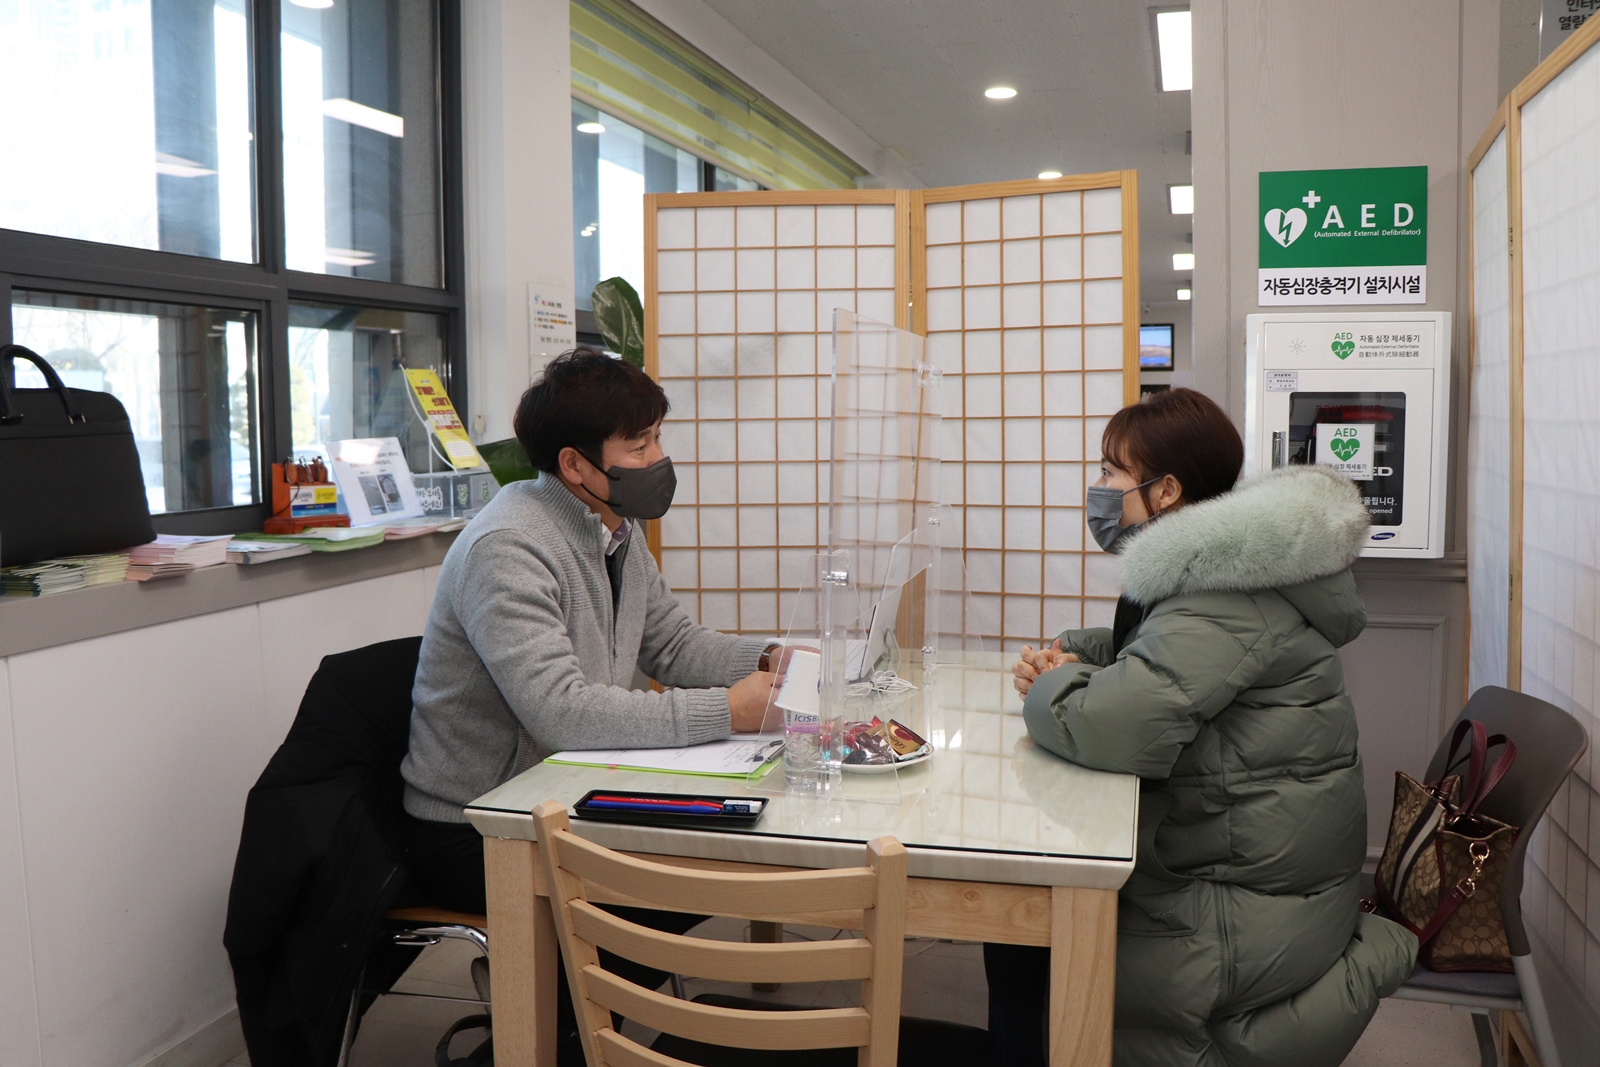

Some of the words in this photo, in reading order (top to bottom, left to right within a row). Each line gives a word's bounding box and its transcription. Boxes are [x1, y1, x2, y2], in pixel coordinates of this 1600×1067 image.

[1566, 0, 1600, 12] 인터
[1559, 13, 1593, 31] 열람
[1313, 230, 1351, 238] (Automated
[1354, 229, 1379, 237] External
[1382, 228, 1421, 237] Defibrillator)
[1263, 276, 1361, 296] 자동심장충격기
[1364, 275, 1421, 294] 설치시설
[1334, 332, 1353, 340] AED
[1359, 335, 1374, 343] 자동
[1375, 335, 1390, 343] 심장
[1391, 334, 1420, 343] 제세동기
[1334, 428, 1357, 437] AED
